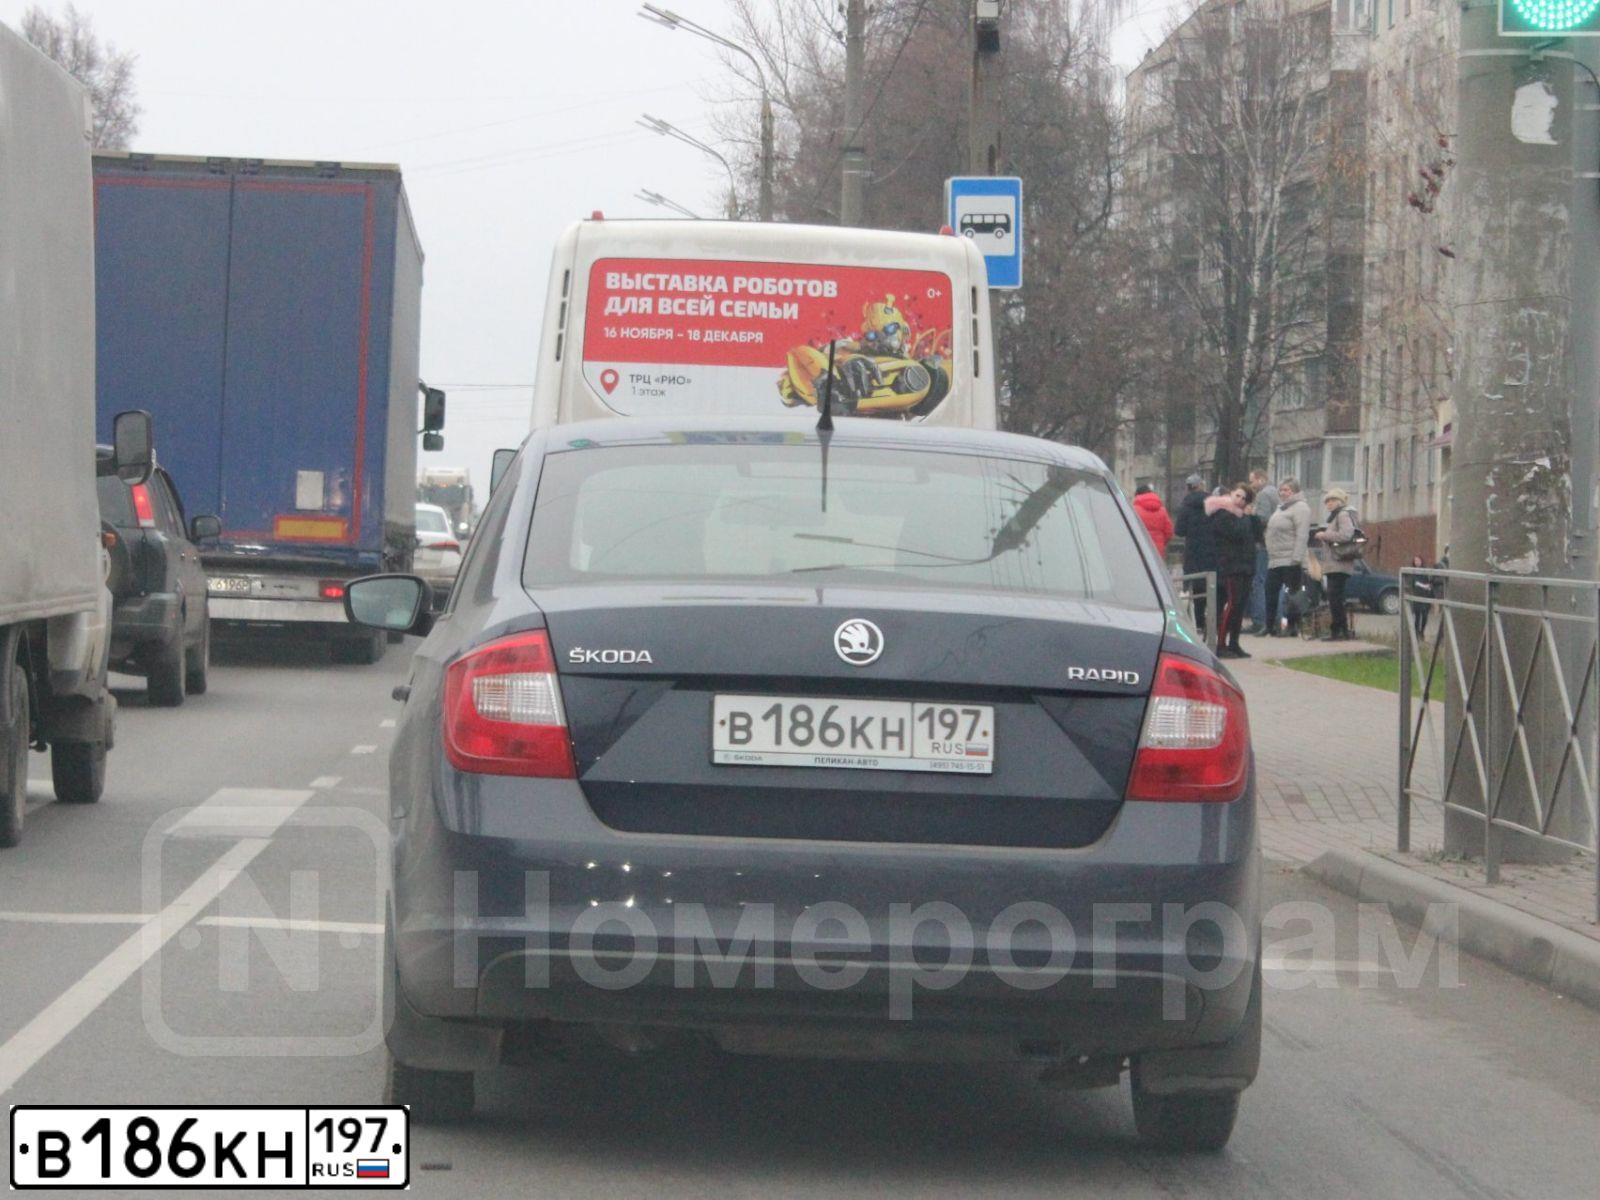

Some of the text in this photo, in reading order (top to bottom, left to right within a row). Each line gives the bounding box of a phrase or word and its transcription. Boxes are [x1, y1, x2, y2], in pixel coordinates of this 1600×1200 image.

[605, 271, 839, 299] ВЫСТАВКА РОБОТОВ
[926, 287, 943, 300] 0+
[603, 294, 799, 321] ДЛЯ ВСЕЙ СЕМЬИ
[603, 326, 618, 339] 16
[620, 326, 675, 341] НОЯБРЯ
[687, 328, 701, 341] 18
[702, 329, 765, 344] ДЕКАБРЯ
[629, 373, 693, 386] ТРЦ «РИО»
[638, 387, 667, 398] этаж
[568, 647, 654, 664] ŠKODA
[1066, 666, 1141, 686] RAPID
[917, 706, 982, 742] 197
[931, 742, 964, 755] RUS
